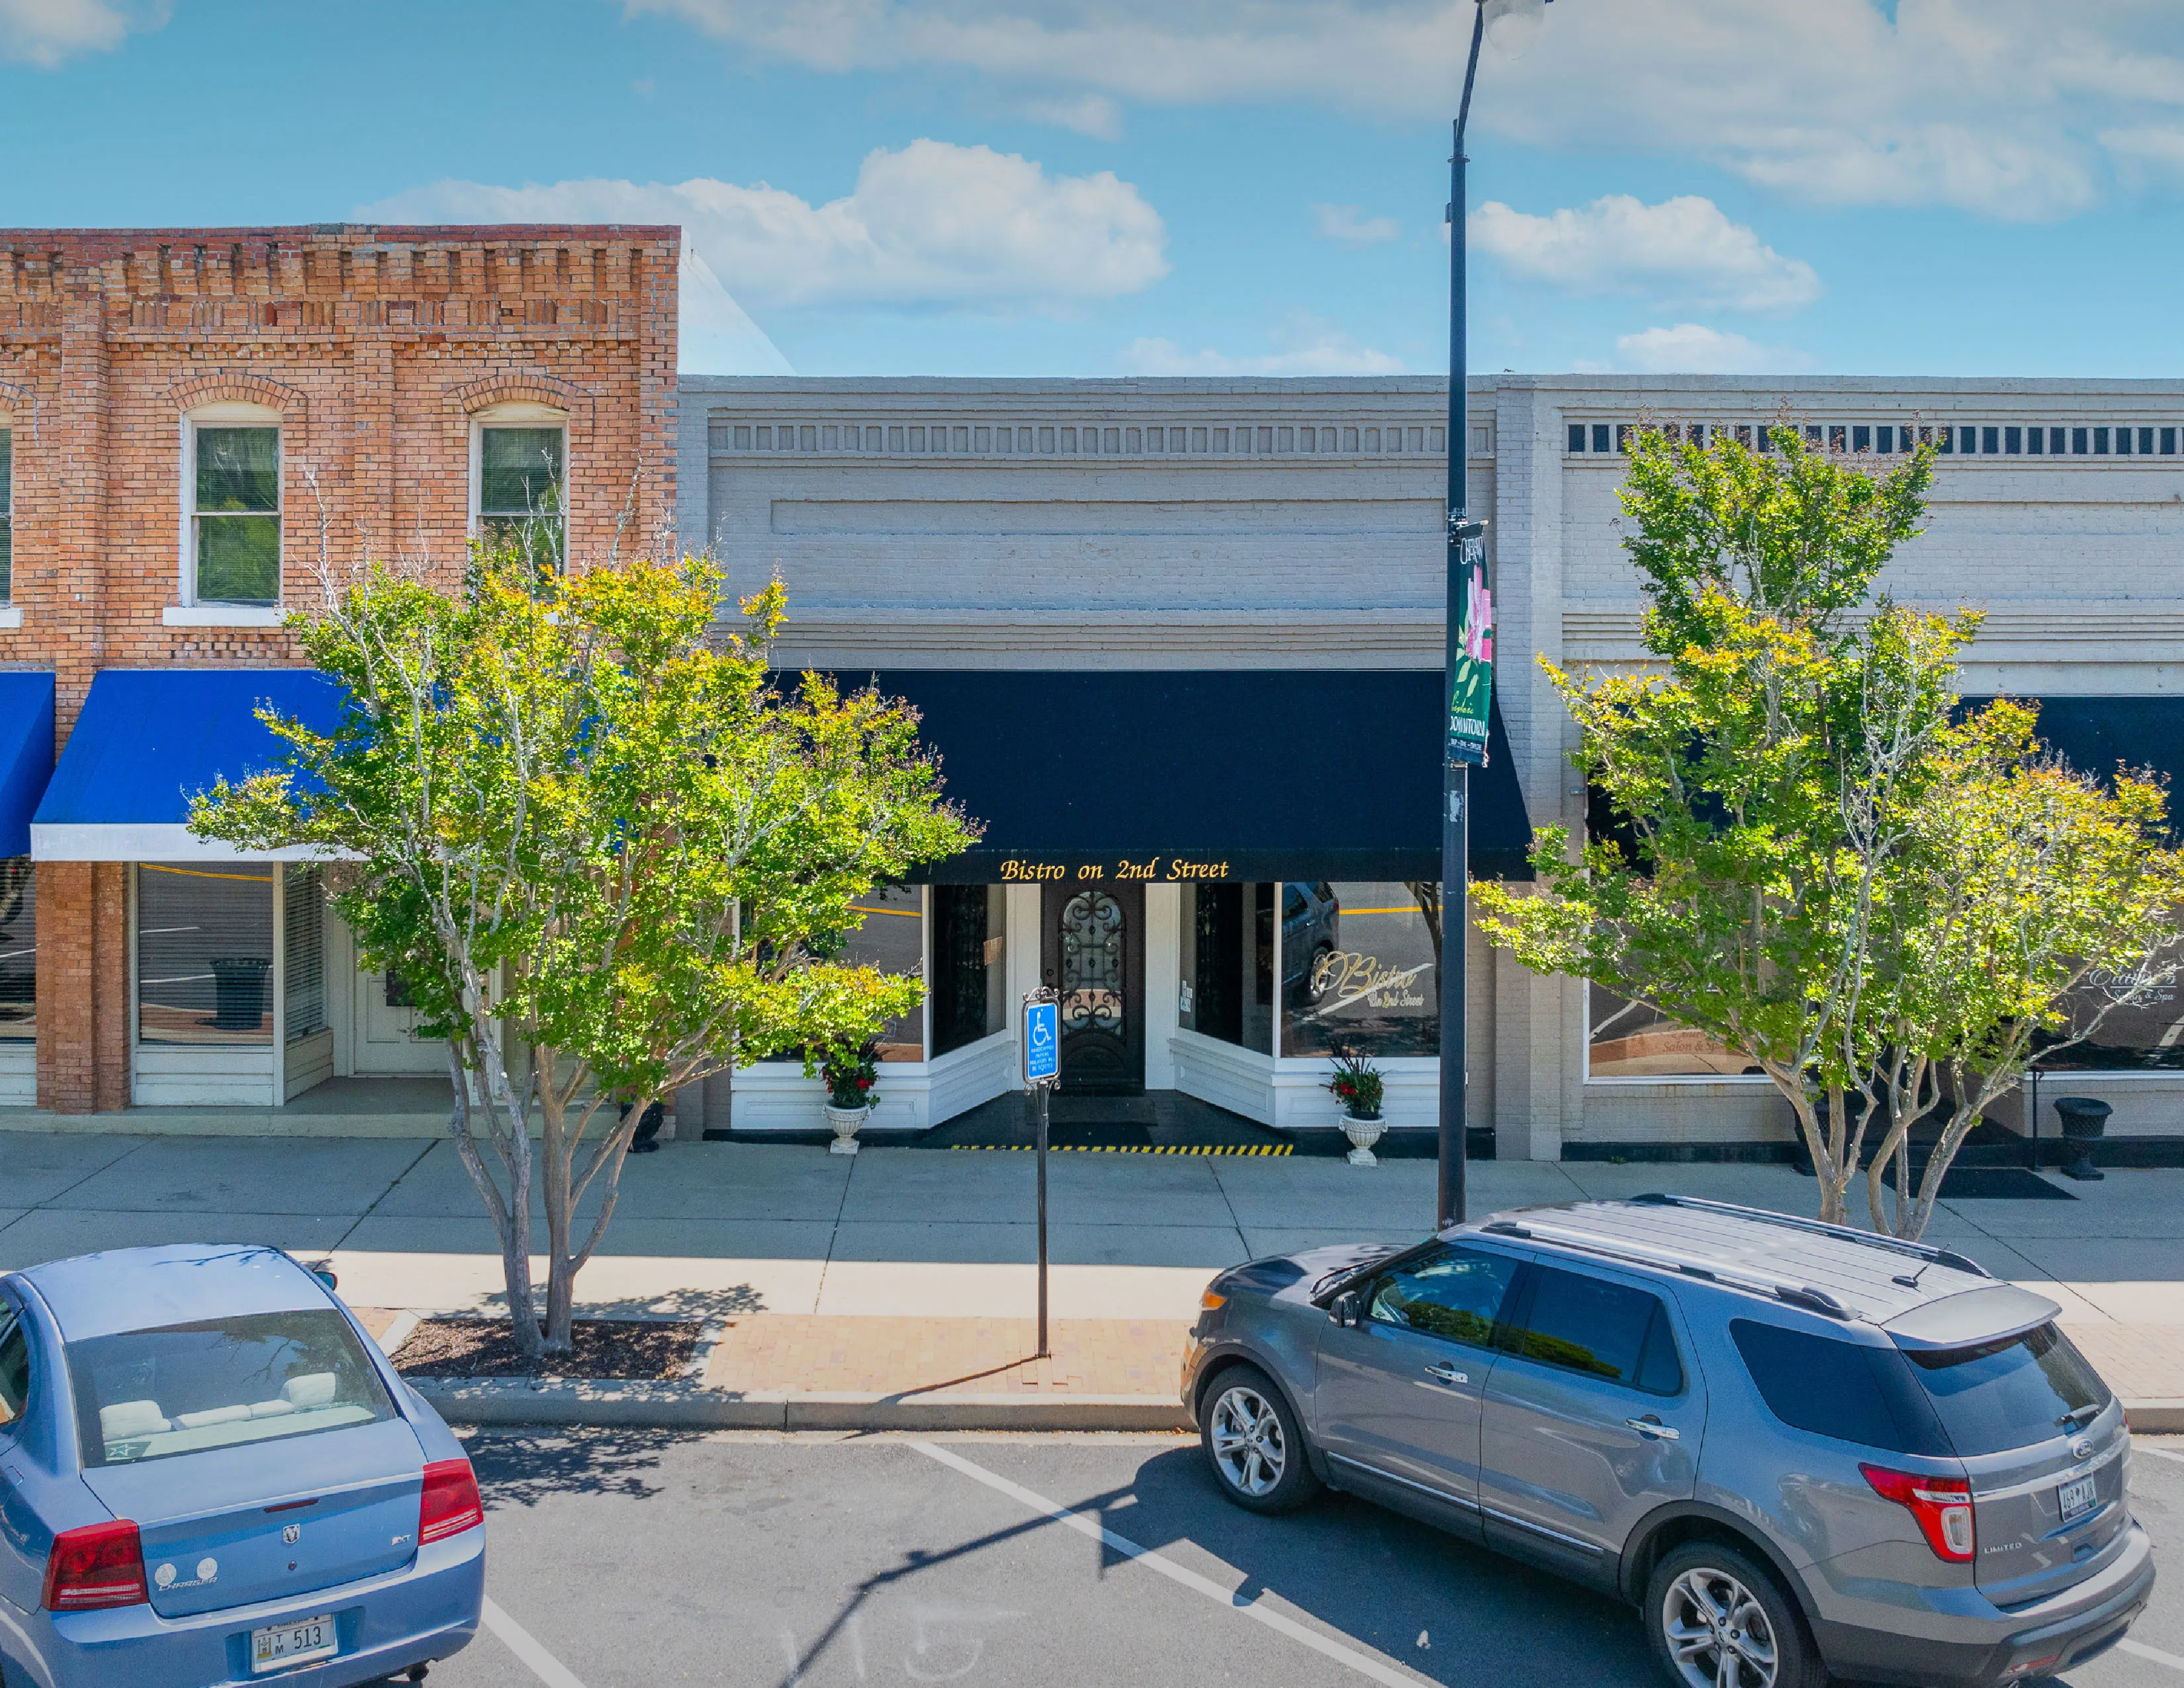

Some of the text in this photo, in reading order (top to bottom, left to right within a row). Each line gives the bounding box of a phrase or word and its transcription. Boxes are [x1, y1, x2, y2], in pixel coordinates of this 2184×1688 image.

[1450, 716, 1485, 737] DOWNTOWN
[1000, 857, 1230, 880] Bistro on 2nd Street
[1315, 951, 1418, 998] Bistro
[1400, 989, 1424, 1007] Street
[2154, 988, 2174, 1004] Spa
[1983, 1542, 2023, 1554] LIMITED
[158, 1576, 218, 1591] CHARGER
[276, 1634, 283, 1644] T
[294, 1626, 321, 1650] 513
[275, 1644, 284, 1655] M
